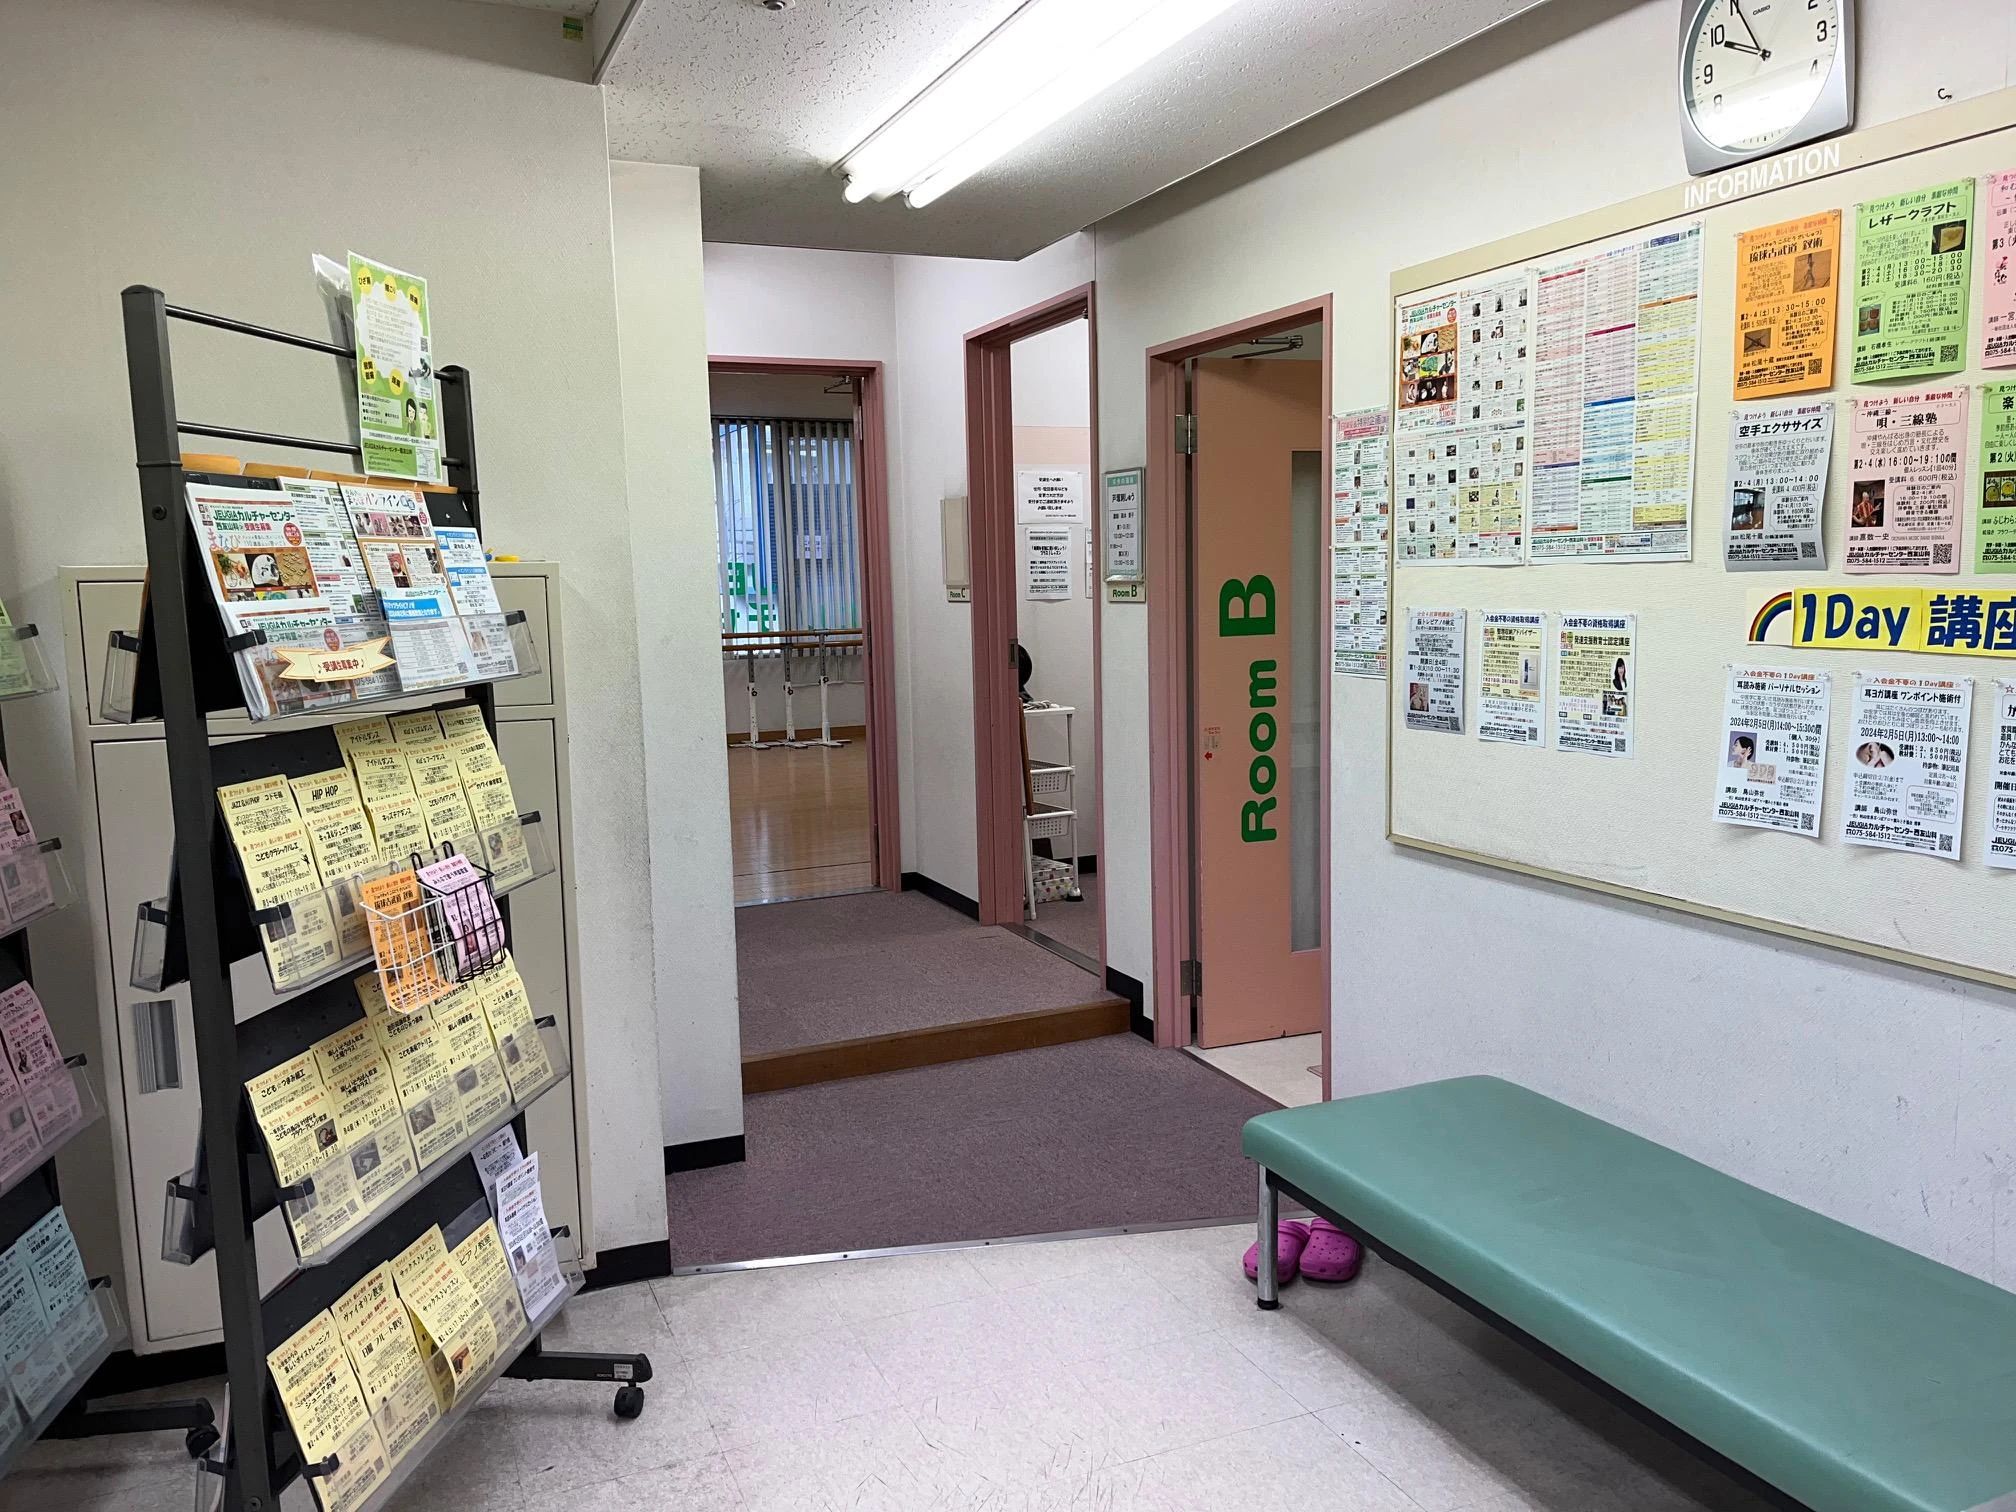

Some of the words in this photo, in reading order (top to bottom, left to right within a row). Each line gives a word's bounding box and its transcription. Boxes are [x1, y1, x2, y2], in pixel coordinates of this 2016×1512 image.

[1753, 5, 1770, 15] CASIO
[1711, 24, 1724, 47] 10
[1817, 20, 1827, 42] 3
[1704, 64, 1713, 84] 9
[1683, 143, 1840, 209] INFORMATION
[1869, 202, 1956, 229] レザークラフト
[1864, 399, 1888, 408] 見つけよう
[1893, 396, 1920, 404] 新しい自分
[1925, 392, 1953, 401] 素敵な仲間
[1739, 417, 1824, 437] 空手エクササイズ
[1876, 412, 1938, 429] 唄・三線塾
[213, 509, 296, 522] JEUGIAカルチャーセンター
[961, 588, 965, 598] C
[1113, 589, 1130, 598] Room
[1131, 584, 1137, 598] B
[1219, 575, 1275, 637] B
[1563, 619, 1625, 628] 入会金不要の資格取得講座
[1801, 593, 1911, 646] 1Day
[1737, 681, 1767, 691] 耳読み施術
[1864, 689, 1898, 699] 耳ヨガ講座
[1900, 692, 1961, 704] ワンポイント施術付
[1241, 660, 1277, 842] Room
[312, 789, 323, 801] HIP
[325, 785, 338, 797] HOP
[1846, 821, 1937, 839] JEUGIAカルチャーセンター西友山科
[343, 1281, 384, 1322] ヴァイオリン教室
